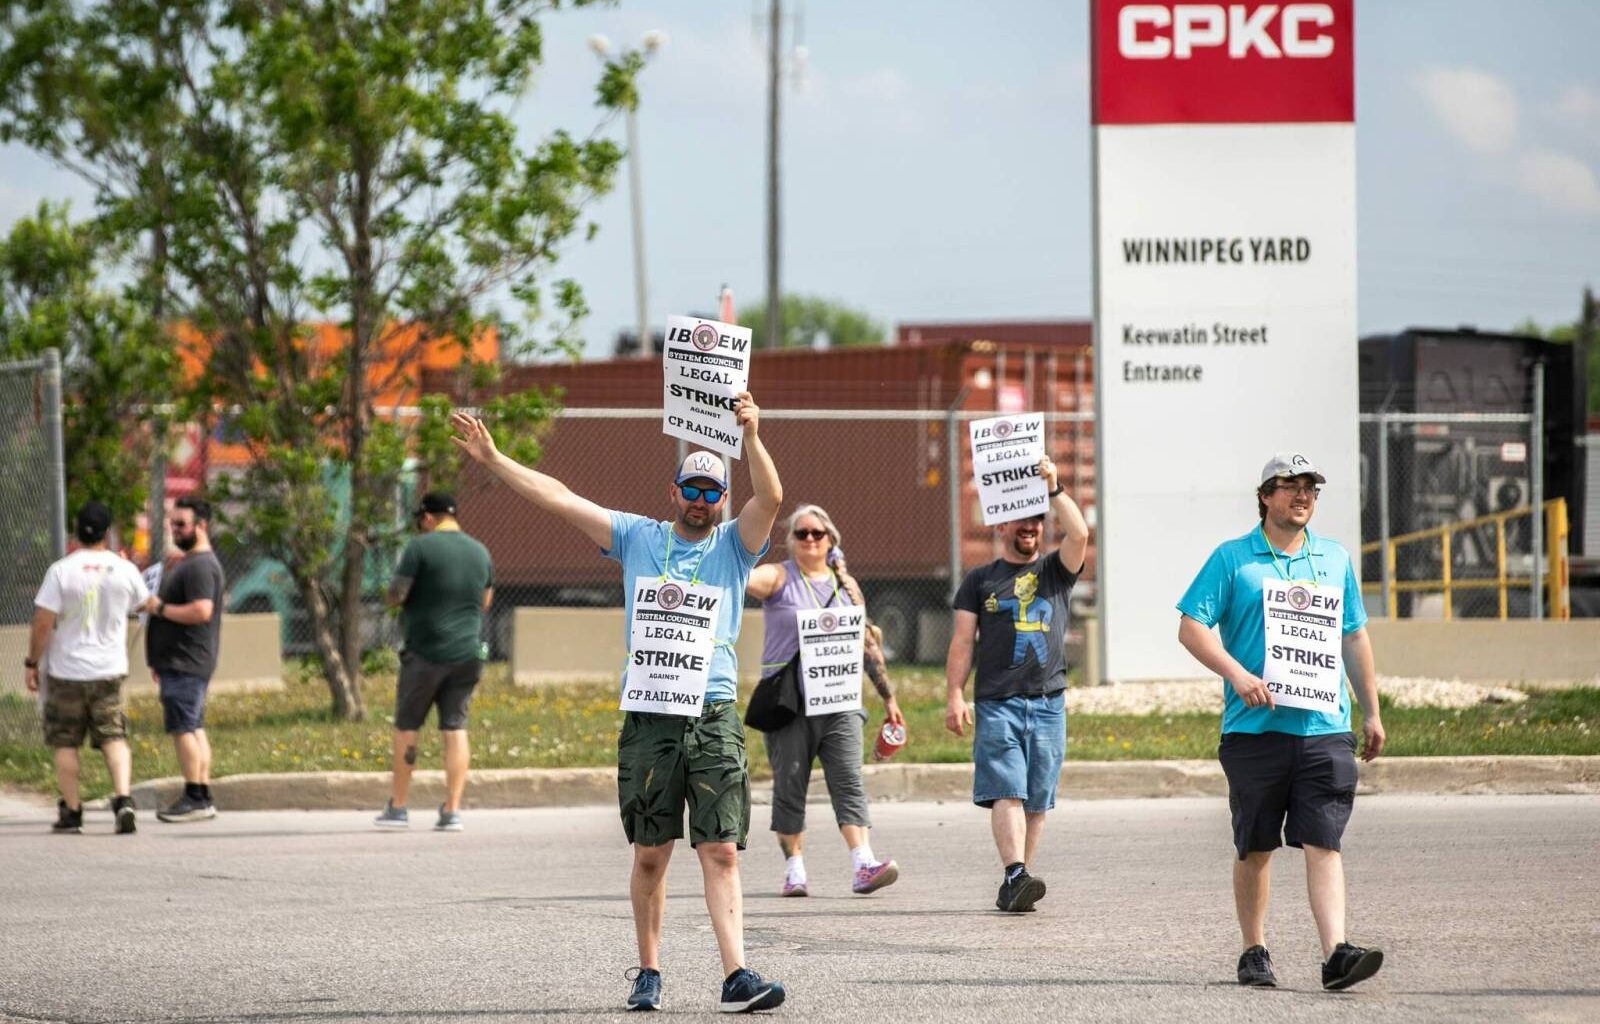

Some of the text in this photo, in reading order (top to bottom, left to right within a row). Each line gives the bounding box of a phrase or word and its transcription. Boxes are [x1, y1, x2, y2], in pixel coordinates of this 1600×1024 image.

[1118, 4, 1335, 59] CPKC
[1122, 237, 1311, 263] WINNIPEG YARD
[1122, 323, 1268, 345] Keewatin Street
[668, 351, 701, 363] SYSTEM
[703, 356, 736, 367] COUNCIL
[680, 366, 732, 385] LEGAL
[1123, 361, 1202, 382] Entrance
[690, 406, 721, 419] AGAINST
[668, 415, 739, 446] CP RAILWAY
[987, 448, 1030, 463] LEGAL
[981, 464, 1041, 486] STRIKE
[986, 494, 1046, 515] CP RAILWAY
[636, 612, 665, 621] SYSTEM
[666, 615, 701, 626] COUNCIL
[645, 626, 696, 643] LEGAL
[1281, 624, 1327, 642] LEGAL
[815, 645, 853, 657] LEGAL
[1272, 645, 1336, 670] STRIKE
[634, 650, 704, 671] STRIKE
[649, 673, 680, 681] AGAINST
[808, 662, 859, 679] STRIKE
[1290, 668, 1318, 678] AGAINST
[628, 689, 700, 705] CP RAILWAY
[1267, 682, 1336, 703] CP RAILWAY
